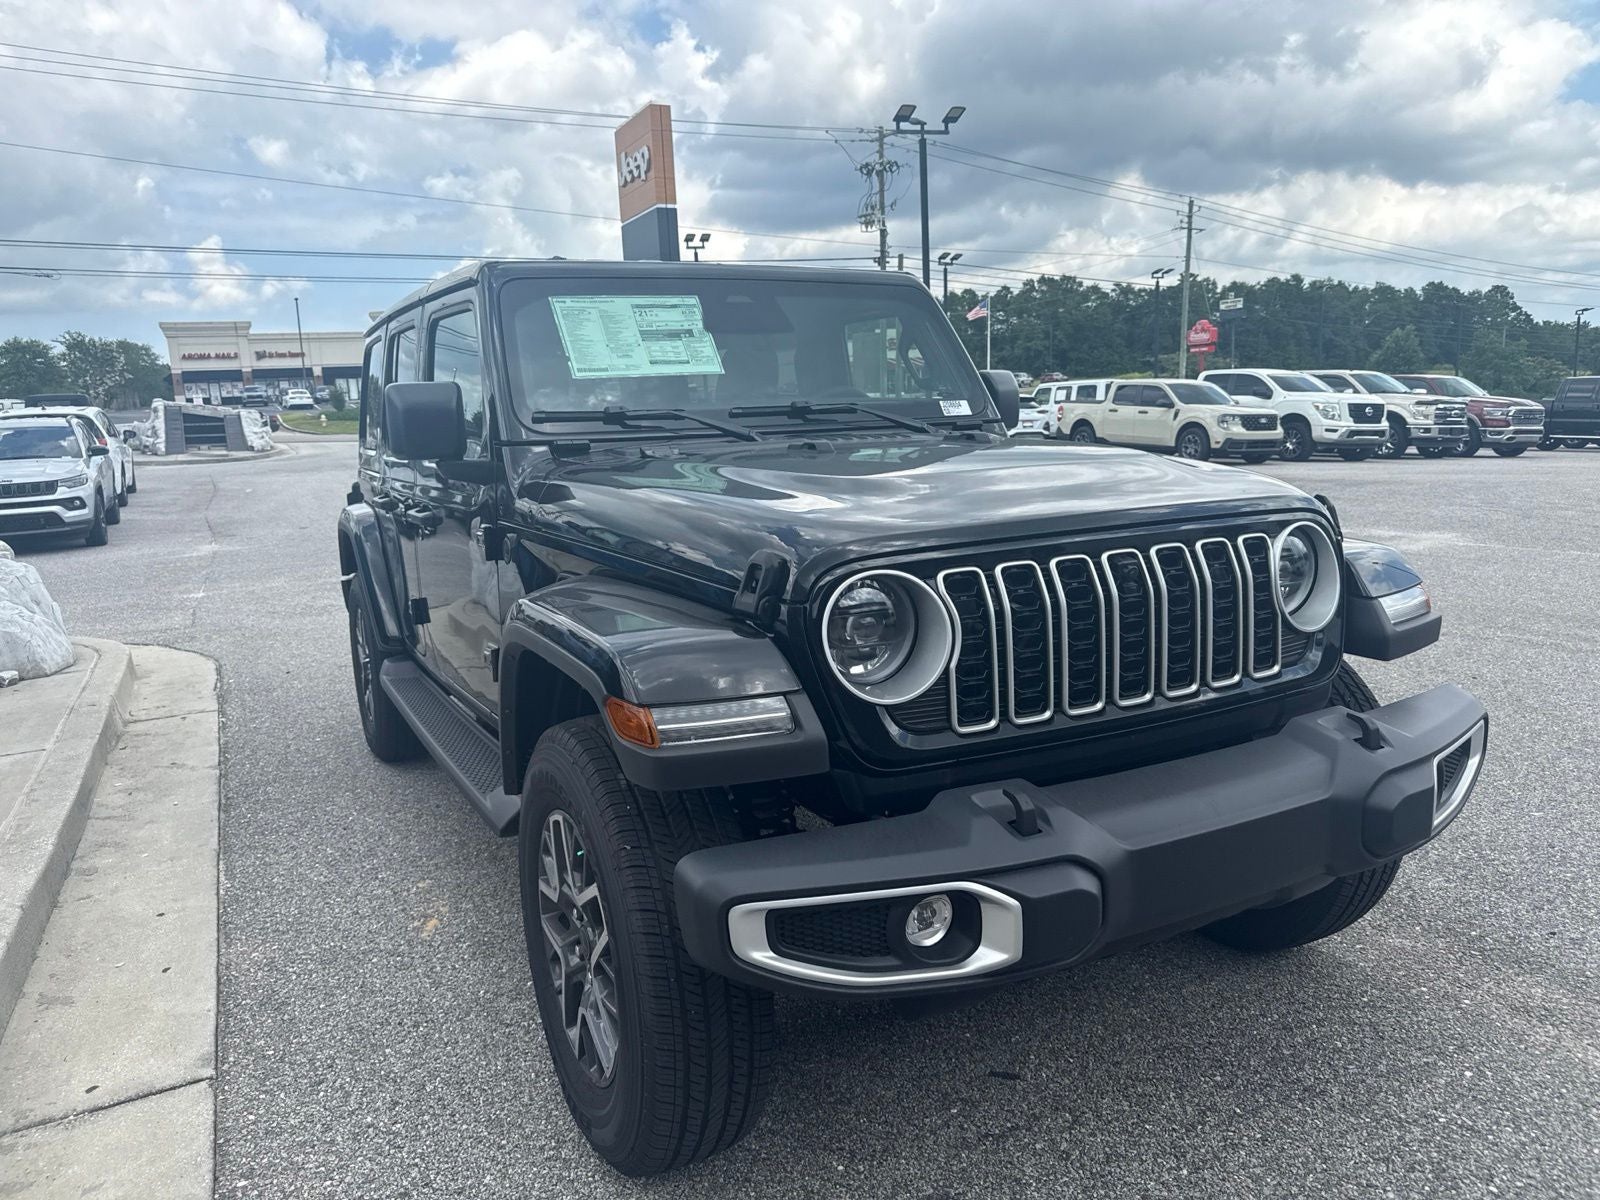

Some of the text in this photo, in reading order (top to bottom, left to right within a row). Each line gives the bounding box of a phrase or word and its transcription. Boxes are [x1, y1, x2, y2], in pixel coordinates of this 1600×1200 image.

[619, 145, 650, 187] Jeep
[181, 351, 239, 360] AROMA NAILS
